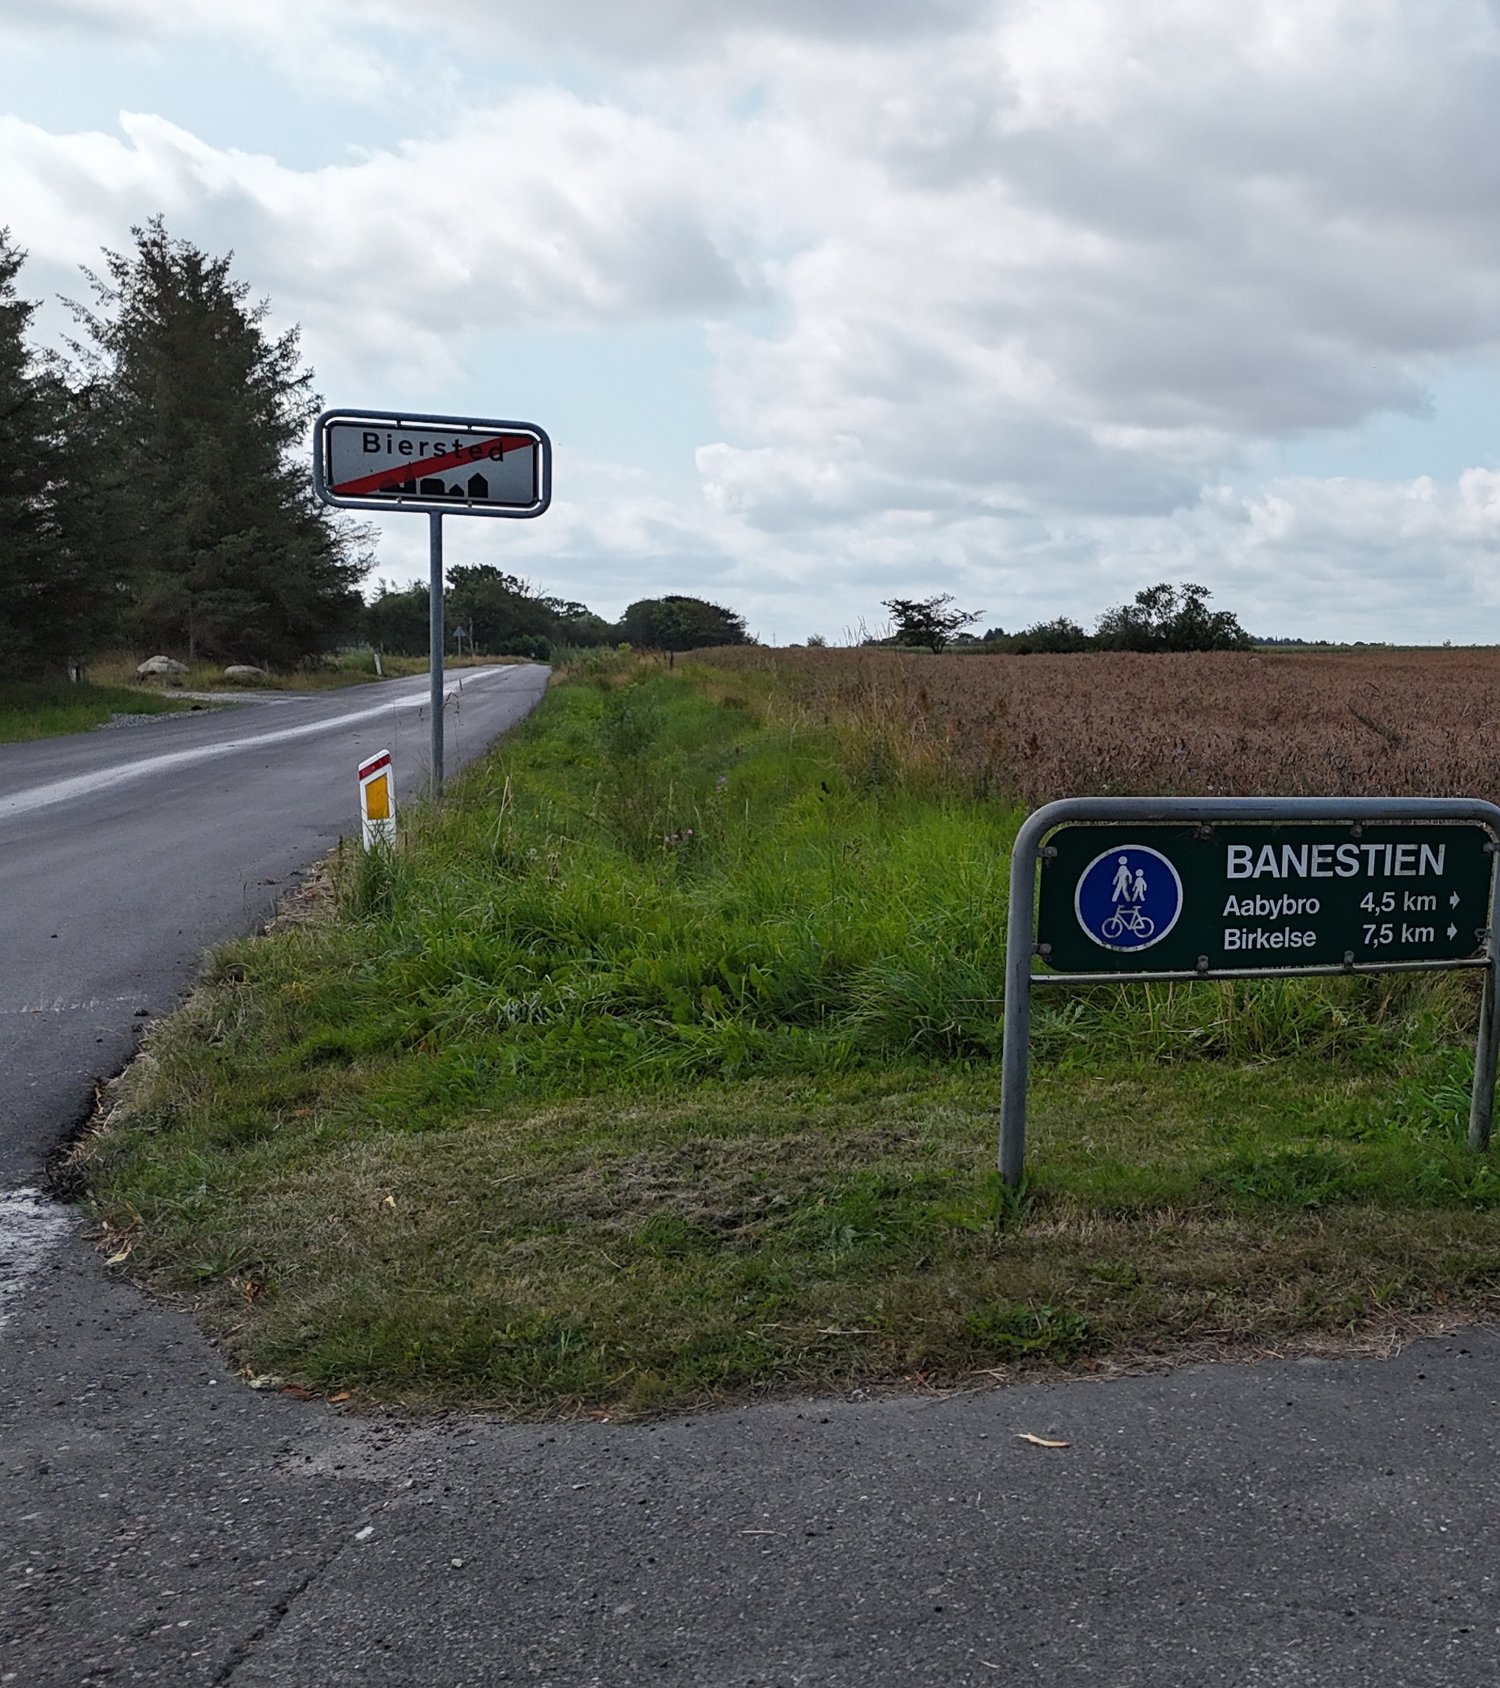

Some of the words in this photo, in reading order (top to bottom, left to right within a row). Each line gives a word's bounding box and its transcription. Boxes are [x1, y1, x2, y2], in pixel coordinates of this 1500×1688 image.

[363, 432, 504, 462] Biersted
[1226, 843, 1446, 879] BANESTIEN
[1222, 894, 1320, 920] Aabybro
[1360, 892, 1396, 916] 4,5
[1403, 891, 1437, 912] km
[1223, 927, 1317, 950] Birkelse
[1362, 924, 1394, 948] 7,5
[1400, 923, 1435, 943] km
